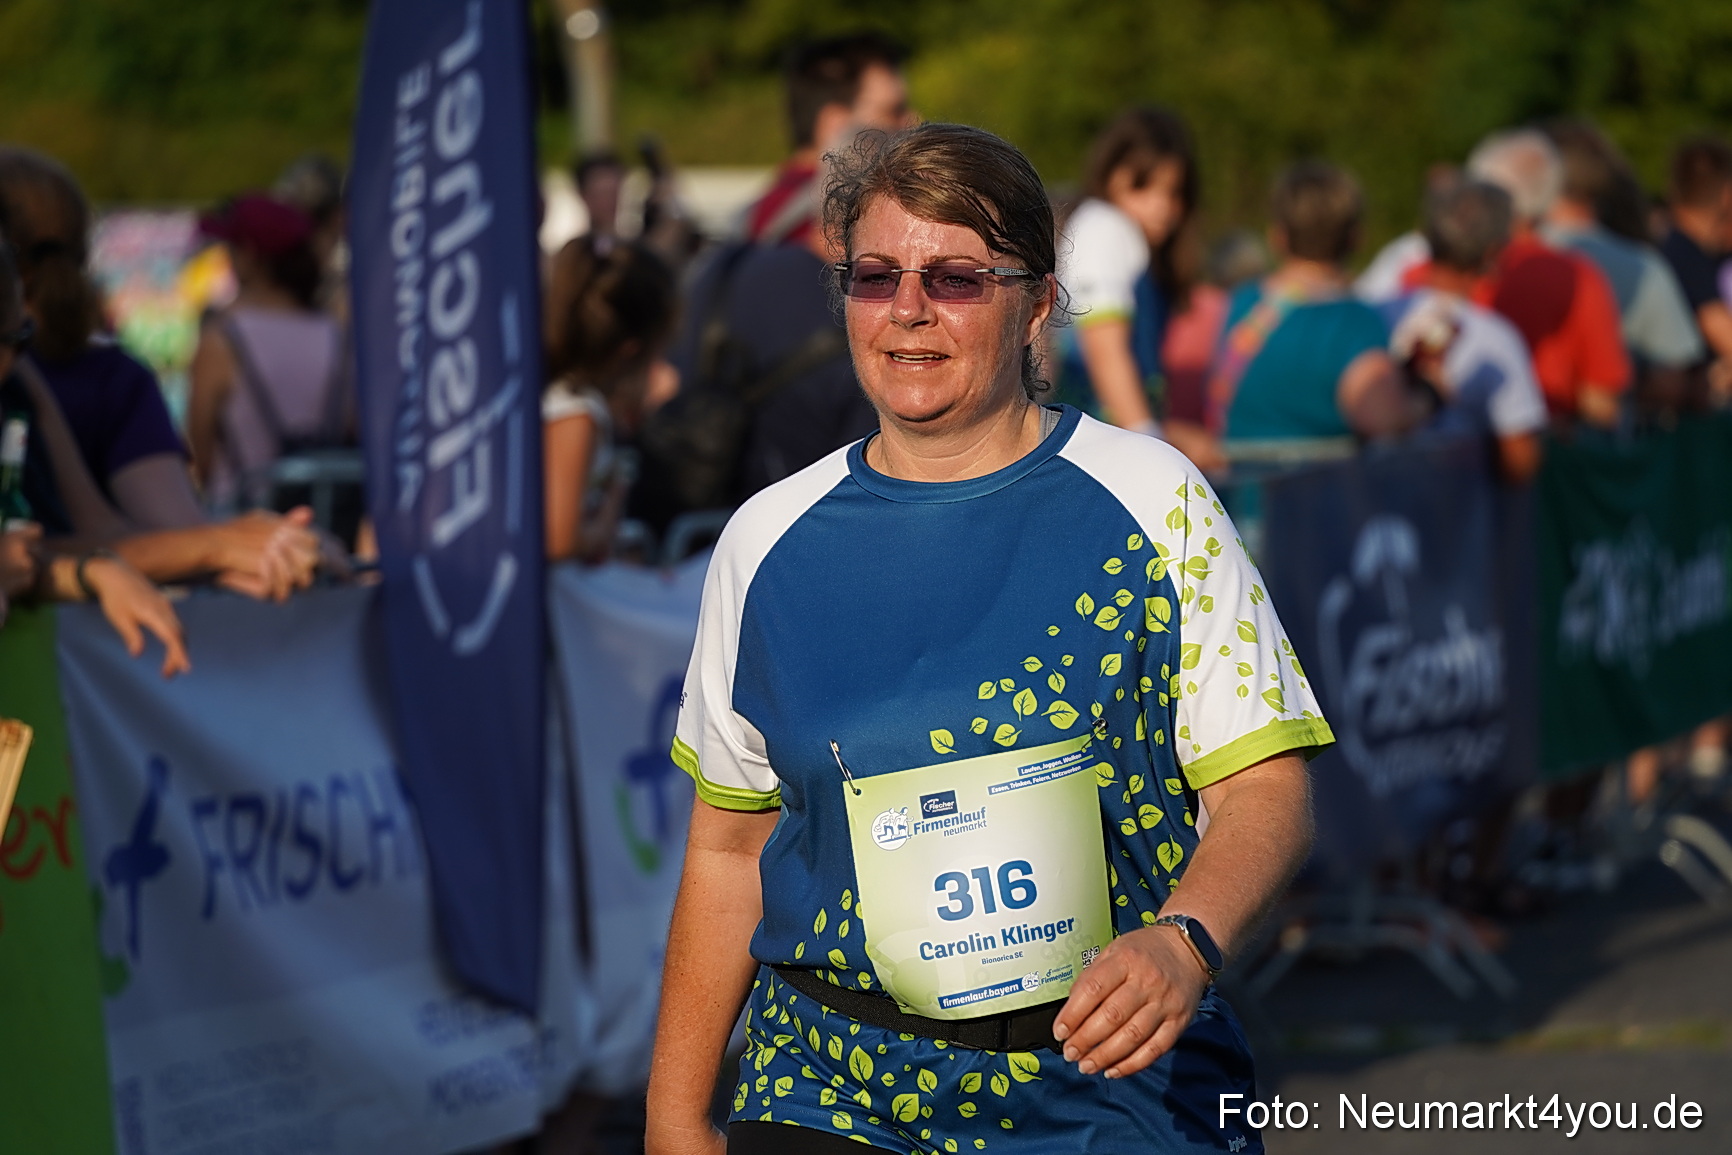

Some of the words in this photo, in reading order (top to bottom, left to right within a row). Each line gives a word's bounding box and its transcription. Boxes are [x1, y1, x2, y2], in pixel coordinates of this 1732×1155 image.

[1051, 765, 1082, 779] Netzwerken
[928, 799, 955, 812] Fischer
[913, 806, 986, 835] Firmenlauf
[943, 820, 987, 837] neumarkt
[934, 860, 1038, 921] 316
[919, 932, 997, 961] Carolin
[1001, 916, 1075, 947] Klinger
[981, 954, 1015, 965] Bionorica
[1014, 951, 1024, 959] SE
[1041, 969, 1073, 985] Firmenlauf
[942, 982, 1019, 1008] firmenlauf.bayern
